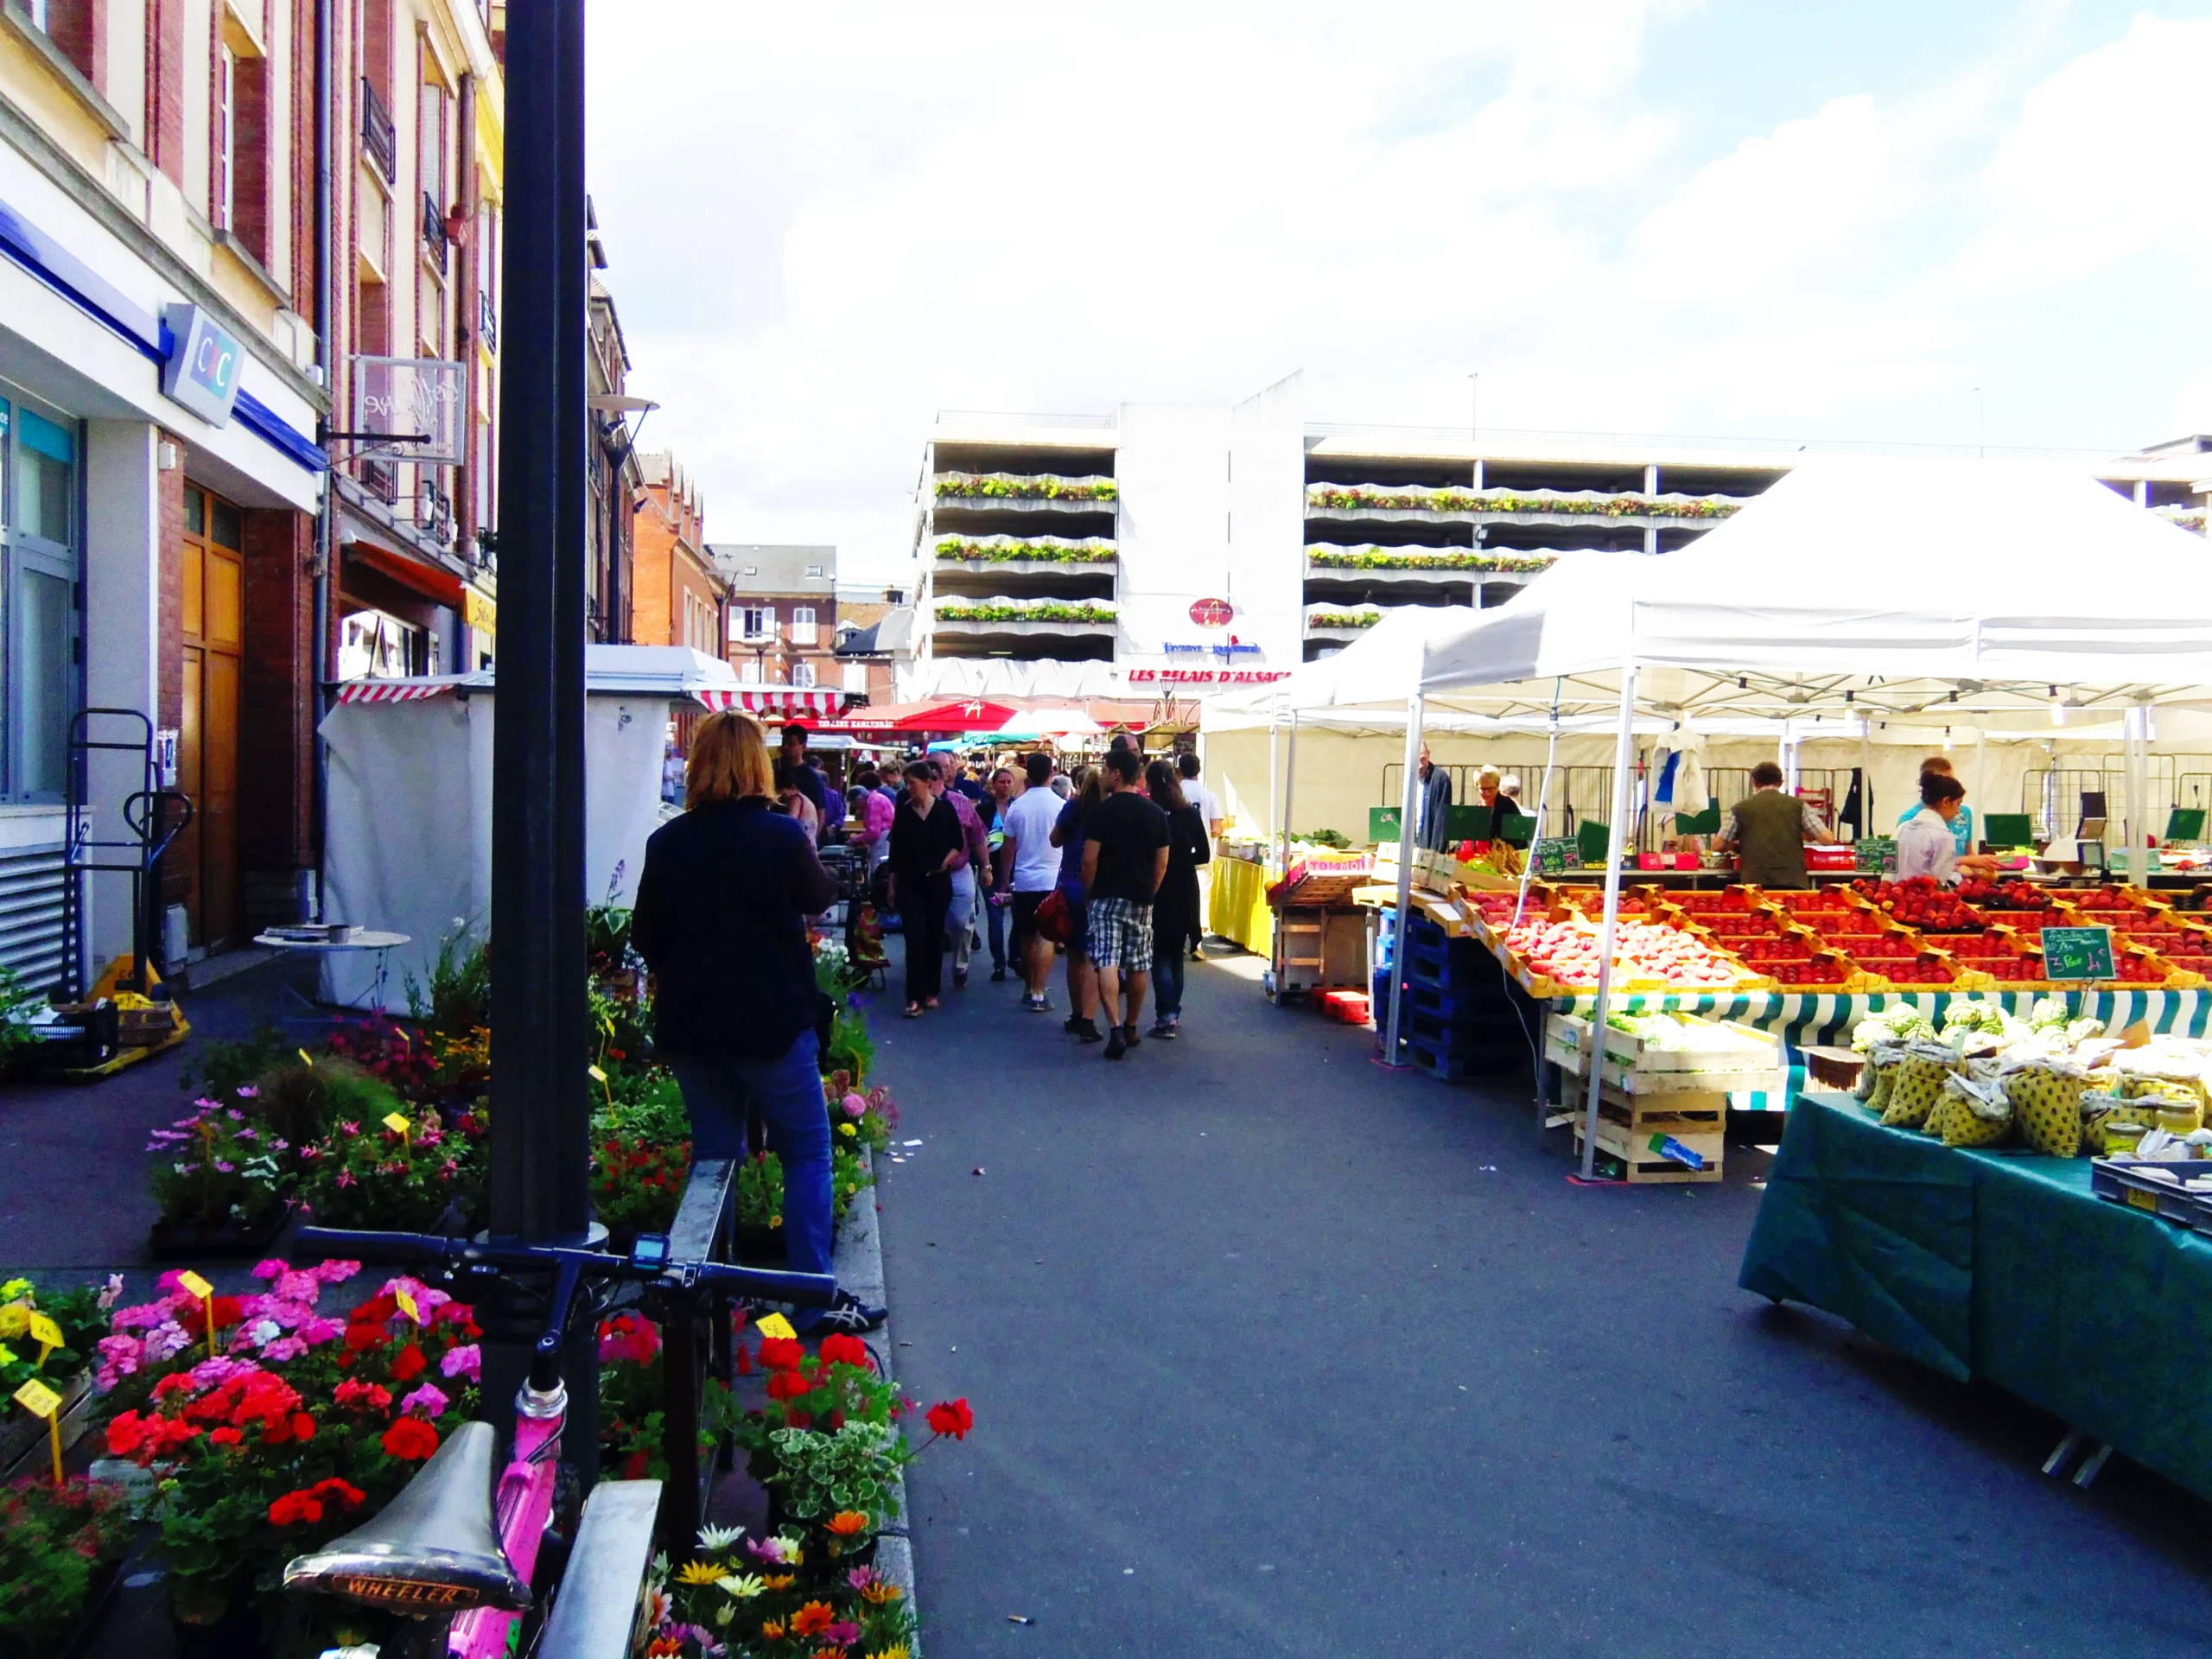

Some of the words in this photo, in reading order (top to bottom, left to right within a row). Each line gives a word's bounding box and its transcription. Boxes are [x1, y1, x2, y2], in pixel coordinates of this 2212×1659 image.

[197, 336, 232, 387] CIC
[1128, 670, 1155, 682] LES
[348, 1580, 459, 1604] WHEELER
